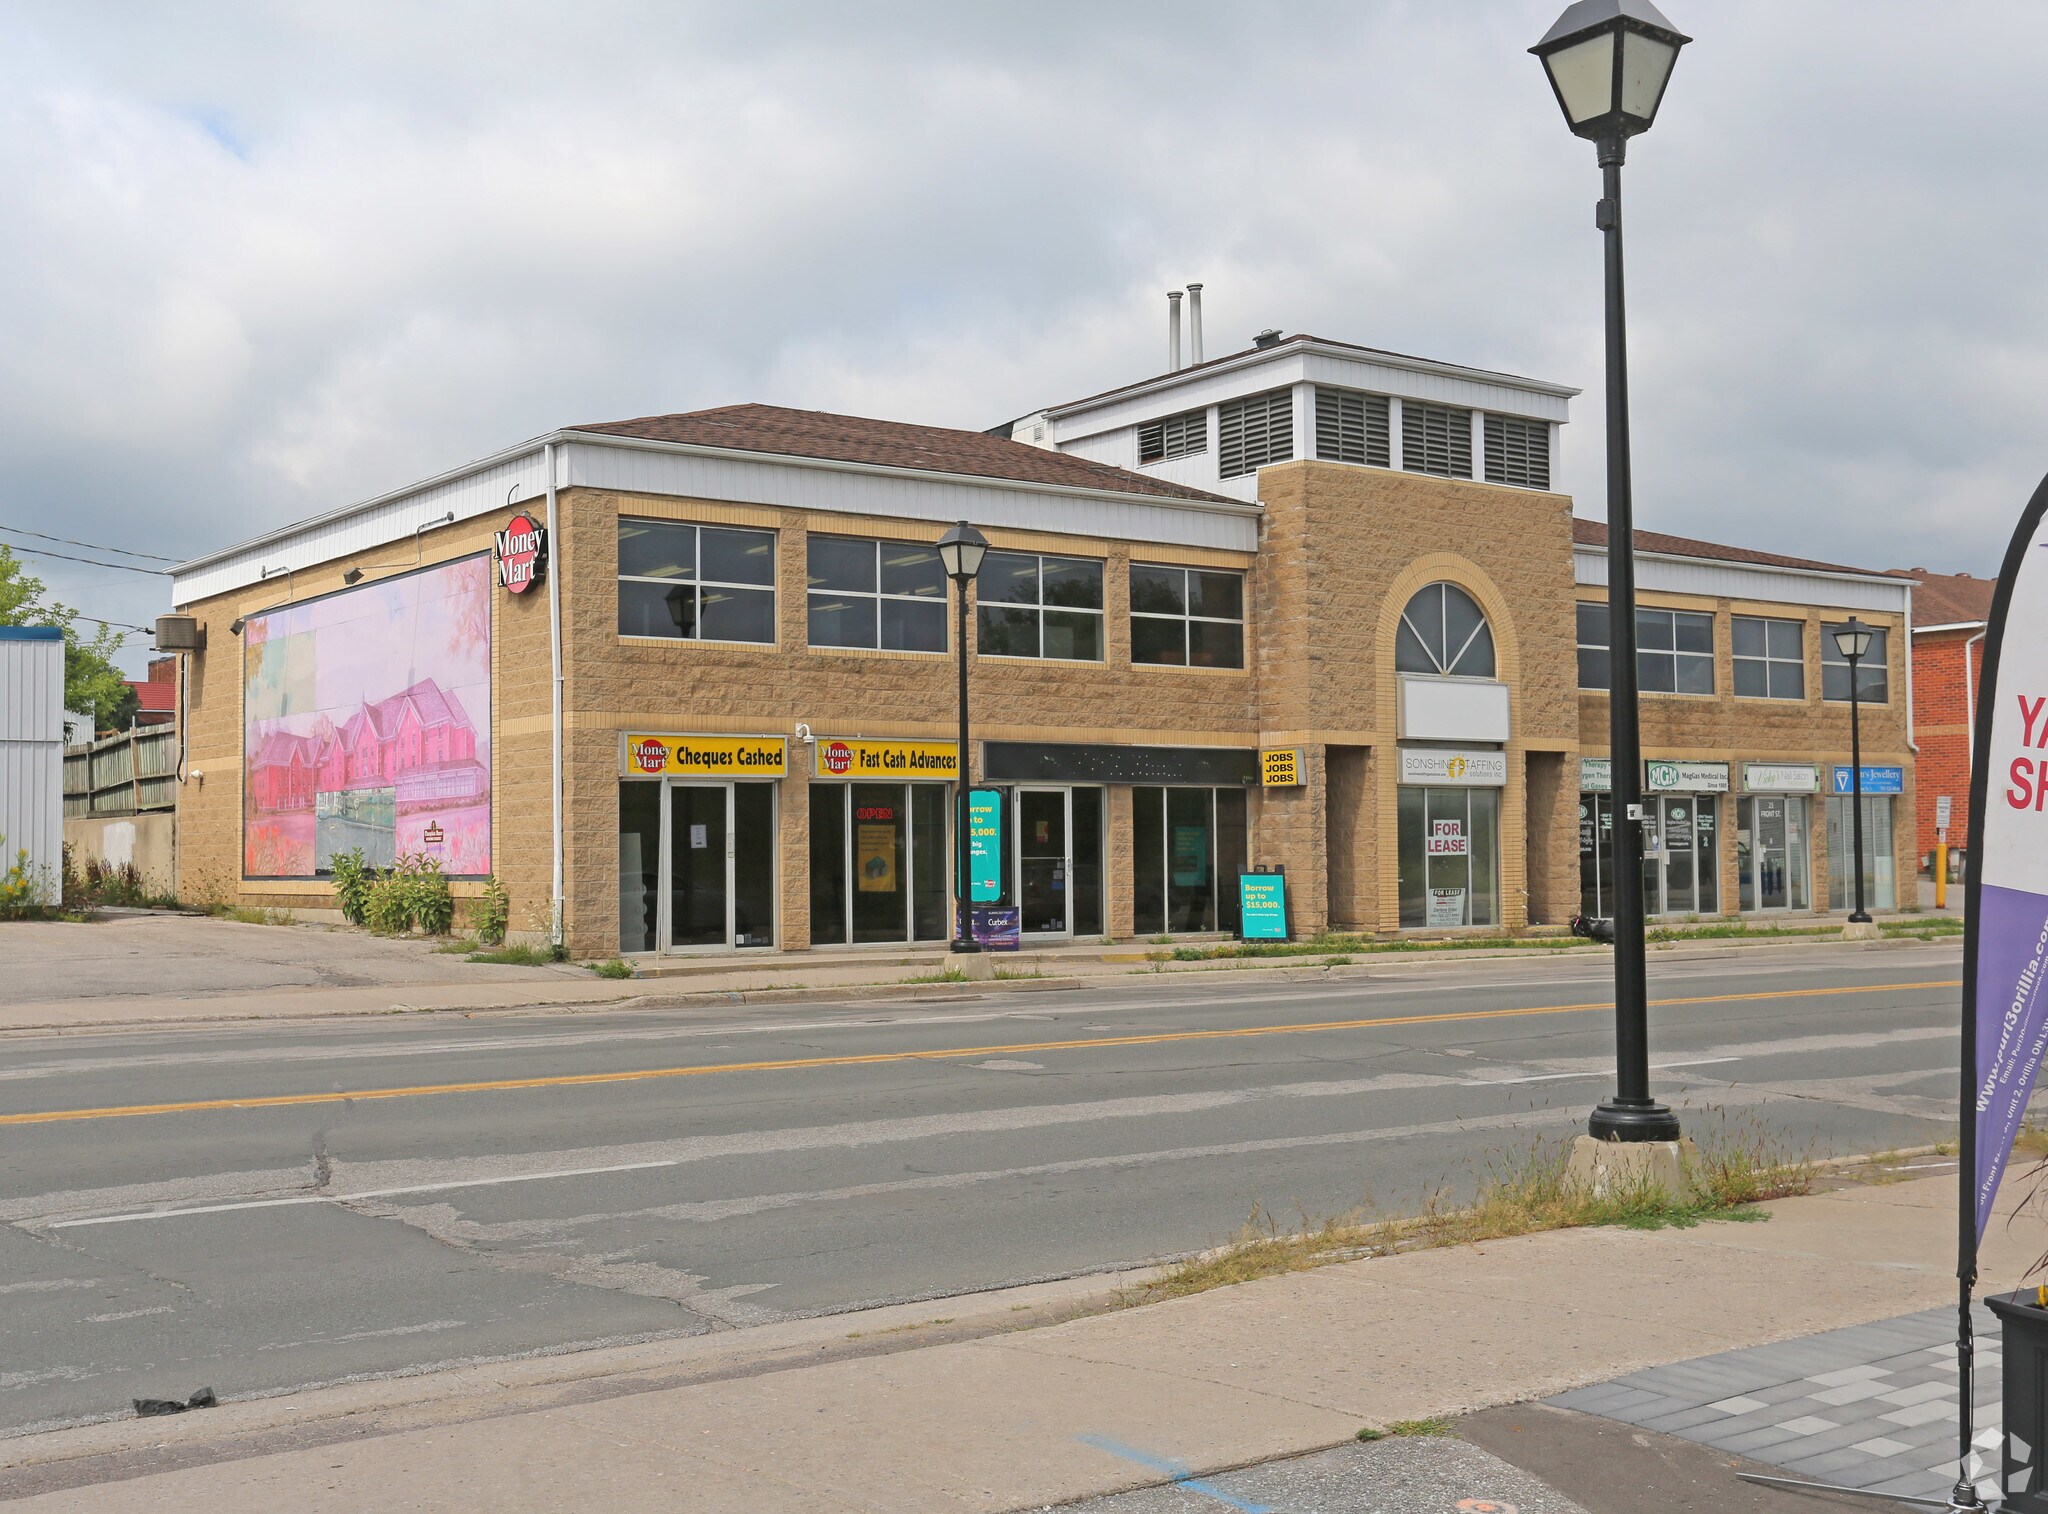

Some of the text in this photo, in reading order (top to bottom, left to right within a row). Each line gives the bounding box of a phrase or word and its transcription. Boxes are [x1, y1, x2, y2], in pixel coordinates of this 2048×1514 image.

[495, 529, 544, 559] Money
[499, 556, 536, 586] Mart
[631, 743, 672, 758] Money
[819, 746, 857, 760] Money
[635, 755, 666, 768] Mart
[677, 746, 783, 769] Cheques Cashed
[823, 757, 852, 770] Mart
[860, 749, 957, 769] Fast Cash Advances
[1265, 753, 1293, 762] JOBS
[1405, 757, 1503, 771] SONSHINE STAFFING
[1265, 763, 1294, 773] JOBS
[1266, 774, 1294, 783] JOBS
[1650, 765, 1678, 786] MGM
[1681, 772, 1700, 780] MagGas
[1870, 769, 1900, 782] Jewellery
[857, 807, 893, 820] OPEN
[1760, 810, 1775, 818] FRONT
[1435, 823, 1460, 836] FOR
[1427, 839, 1466, 853] LEASE
[1703, 836, 1709, 847] 2
[1245, 884, 1275, 892] Borrow
[1245, 893, 1256, 901] up
[1246, 901, 1281, 909] $15,000.
[1999, 1057, 2016, 1084] Email:
[2006, 1098, 2019, 1120] Unit
[2018, 1056, 2037, 1087] Orillia
[2031, 1039, 2044, 1056] ON
[1982, 1165, 1998, 1192] Front
